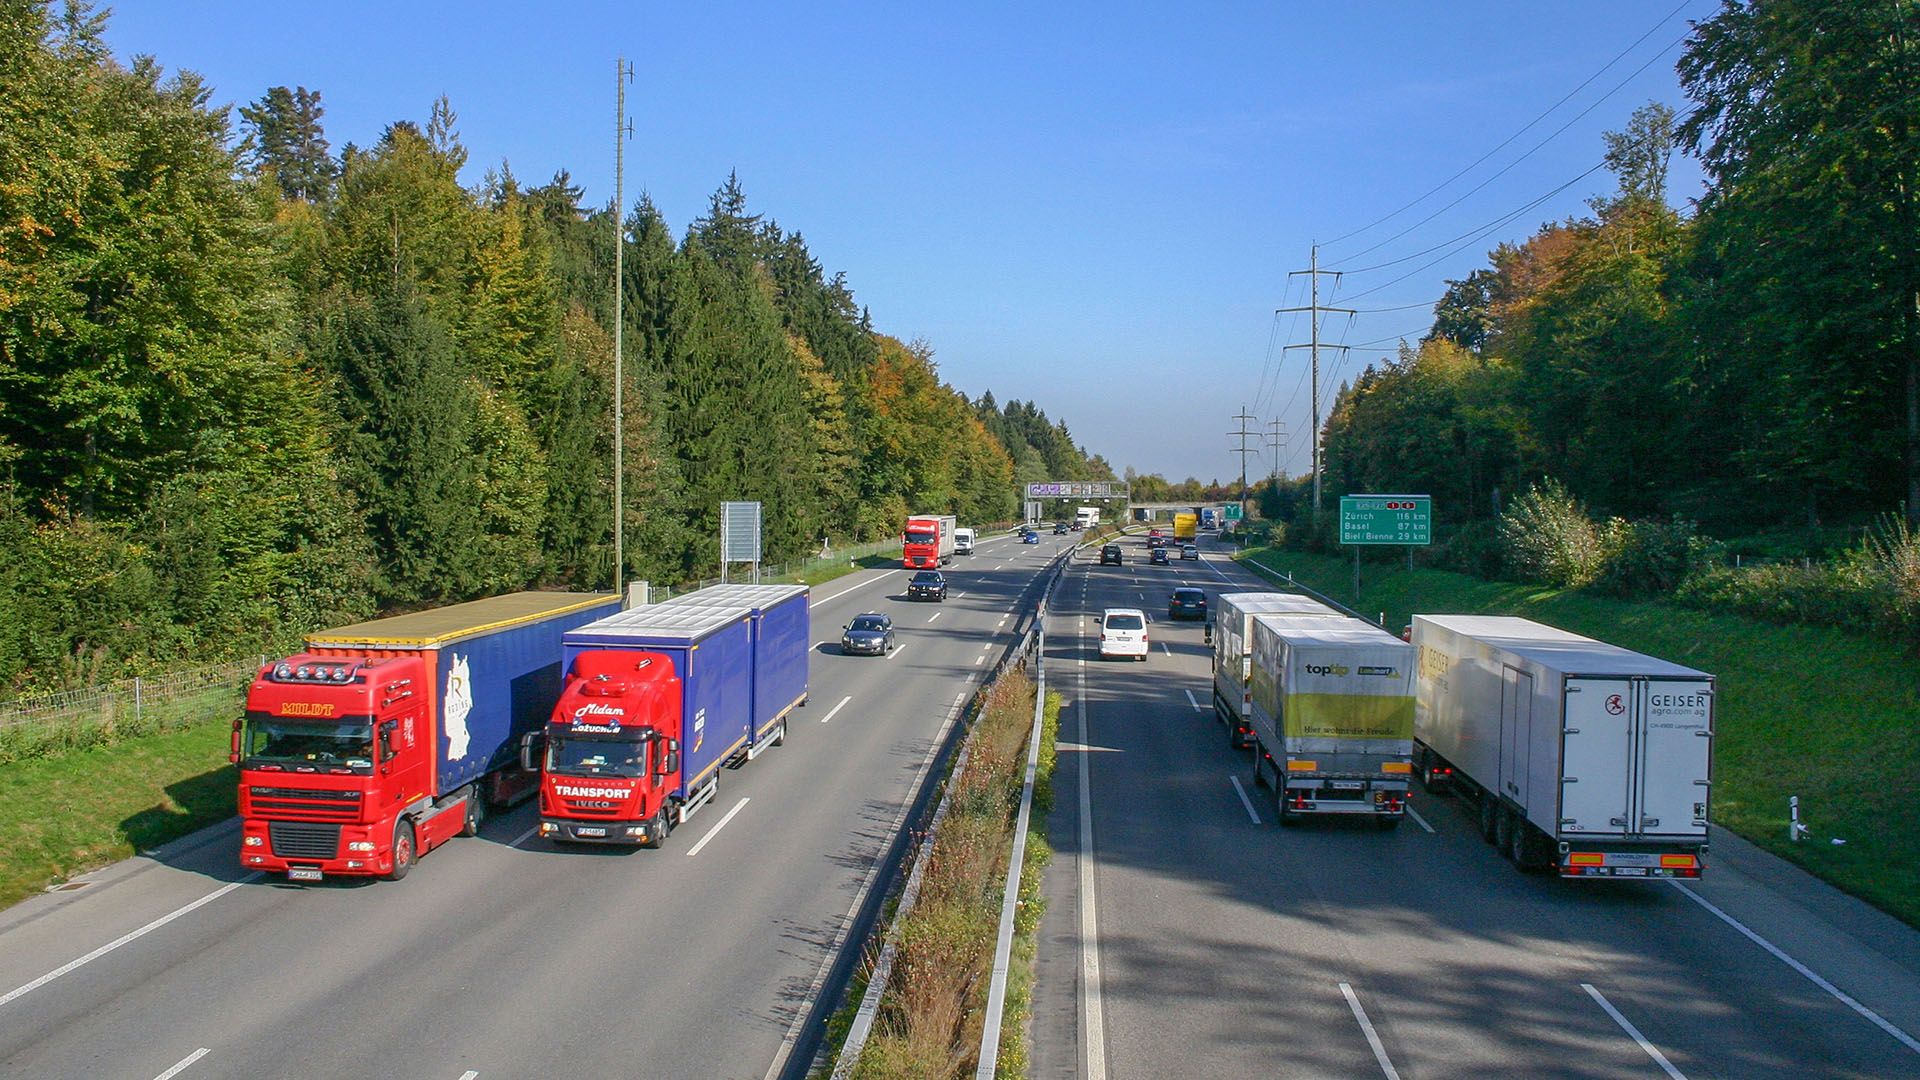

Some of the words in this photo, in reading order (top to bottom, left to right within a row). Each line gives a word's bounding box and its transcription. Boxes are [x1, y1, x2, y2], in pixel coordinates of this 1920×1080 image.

[1345, 512, 1374, 520] Zürich
[1651, 695, 1705, 707] GEISER
[281, 702, 335, 716] MILDT
[575, 703, 624, 717] Midam
[555, 785, 631, 799] TRANSPORT
[575, 800, 610, 808] IVECO
